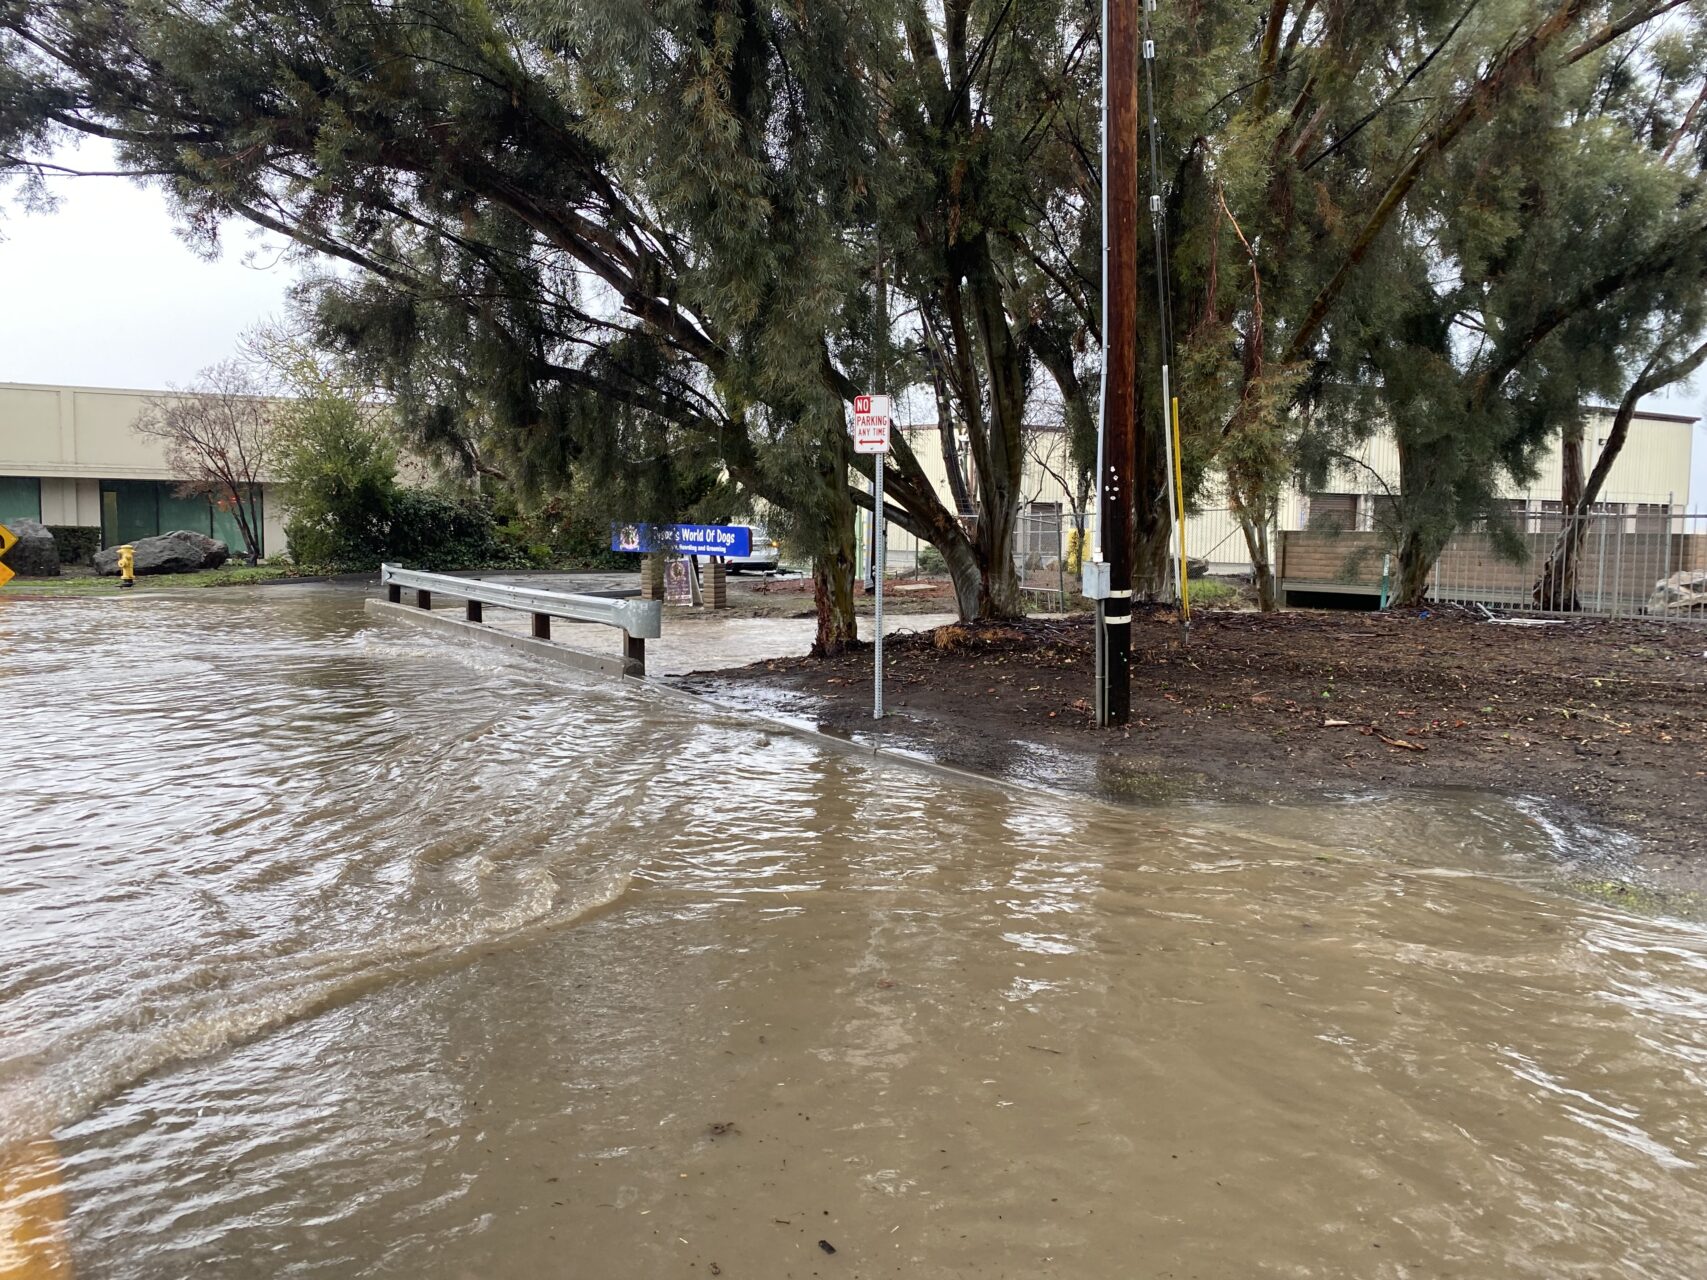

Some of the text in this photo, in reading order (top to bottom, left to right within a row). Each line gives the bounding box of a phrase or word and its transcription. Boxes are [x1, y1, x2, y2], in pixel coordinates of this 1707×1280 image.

[856, 398, 869, 412] NO
[856, 415, 887, 426] PARKING
[858, 428, 886, 436] ANY TIME
[681, 528, 704, 542] World
[705, 529, 715, 543] Of
[716, 529, 735, 546] Dogs
